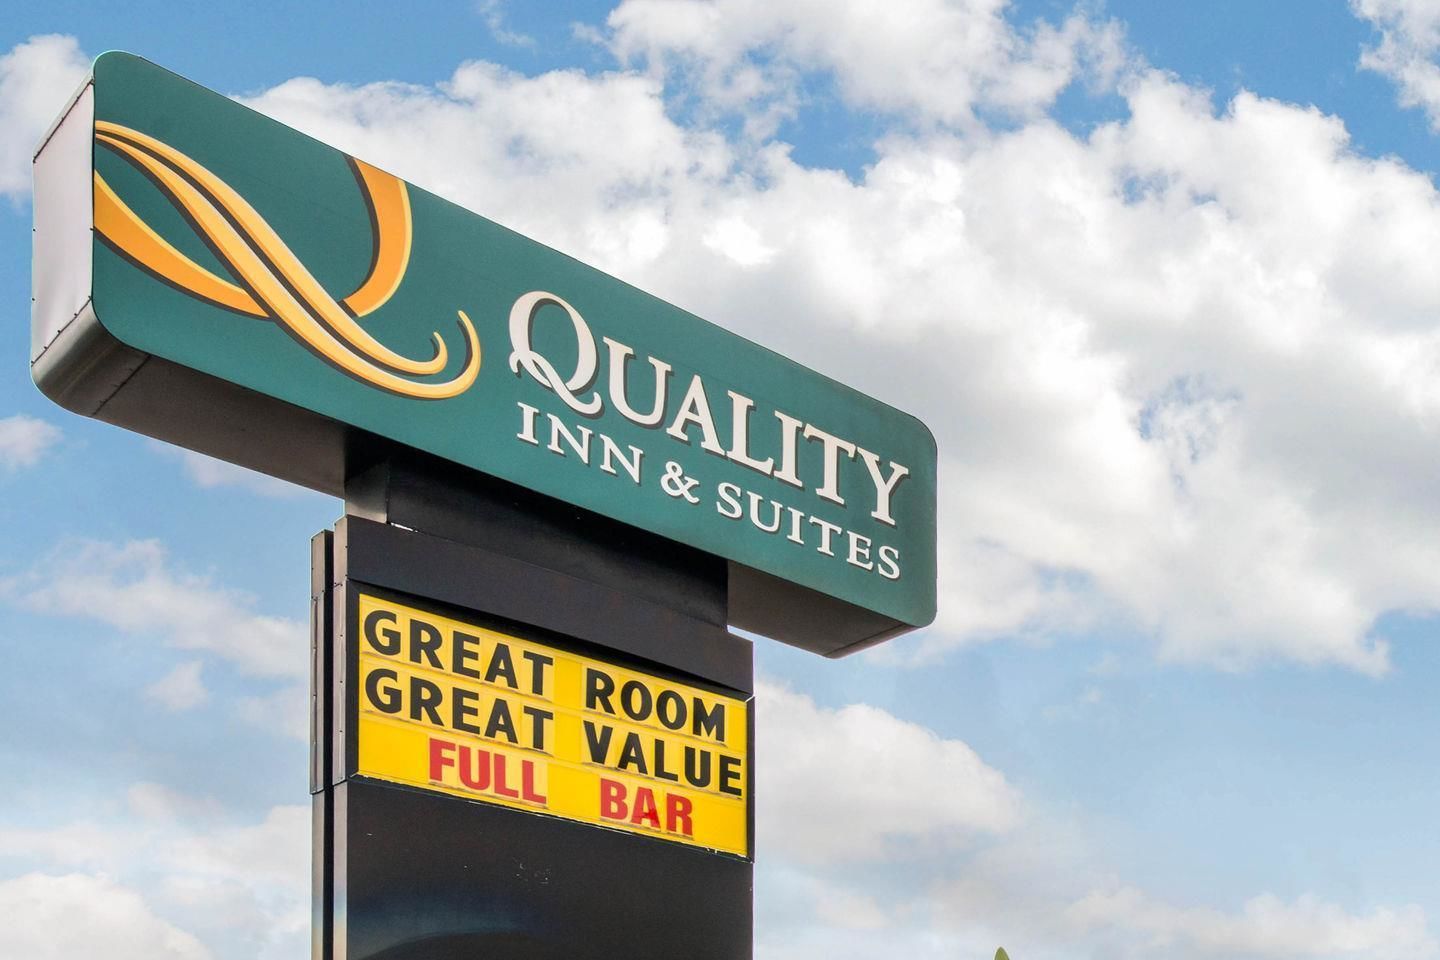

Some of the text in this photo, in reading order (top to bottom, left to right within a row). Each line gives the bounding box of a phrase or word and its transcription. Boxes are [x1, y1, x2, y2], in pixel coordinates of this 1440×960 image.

[508, 290, 910, 527] QUALITY
[517, 401, 901, 580] INN & SUITES
[363, 609, 726, 743] GREAT ROOM
[364, 668, 743, 797] GREAT VALUE
[428, 737, 694, 836] FULL BAR
